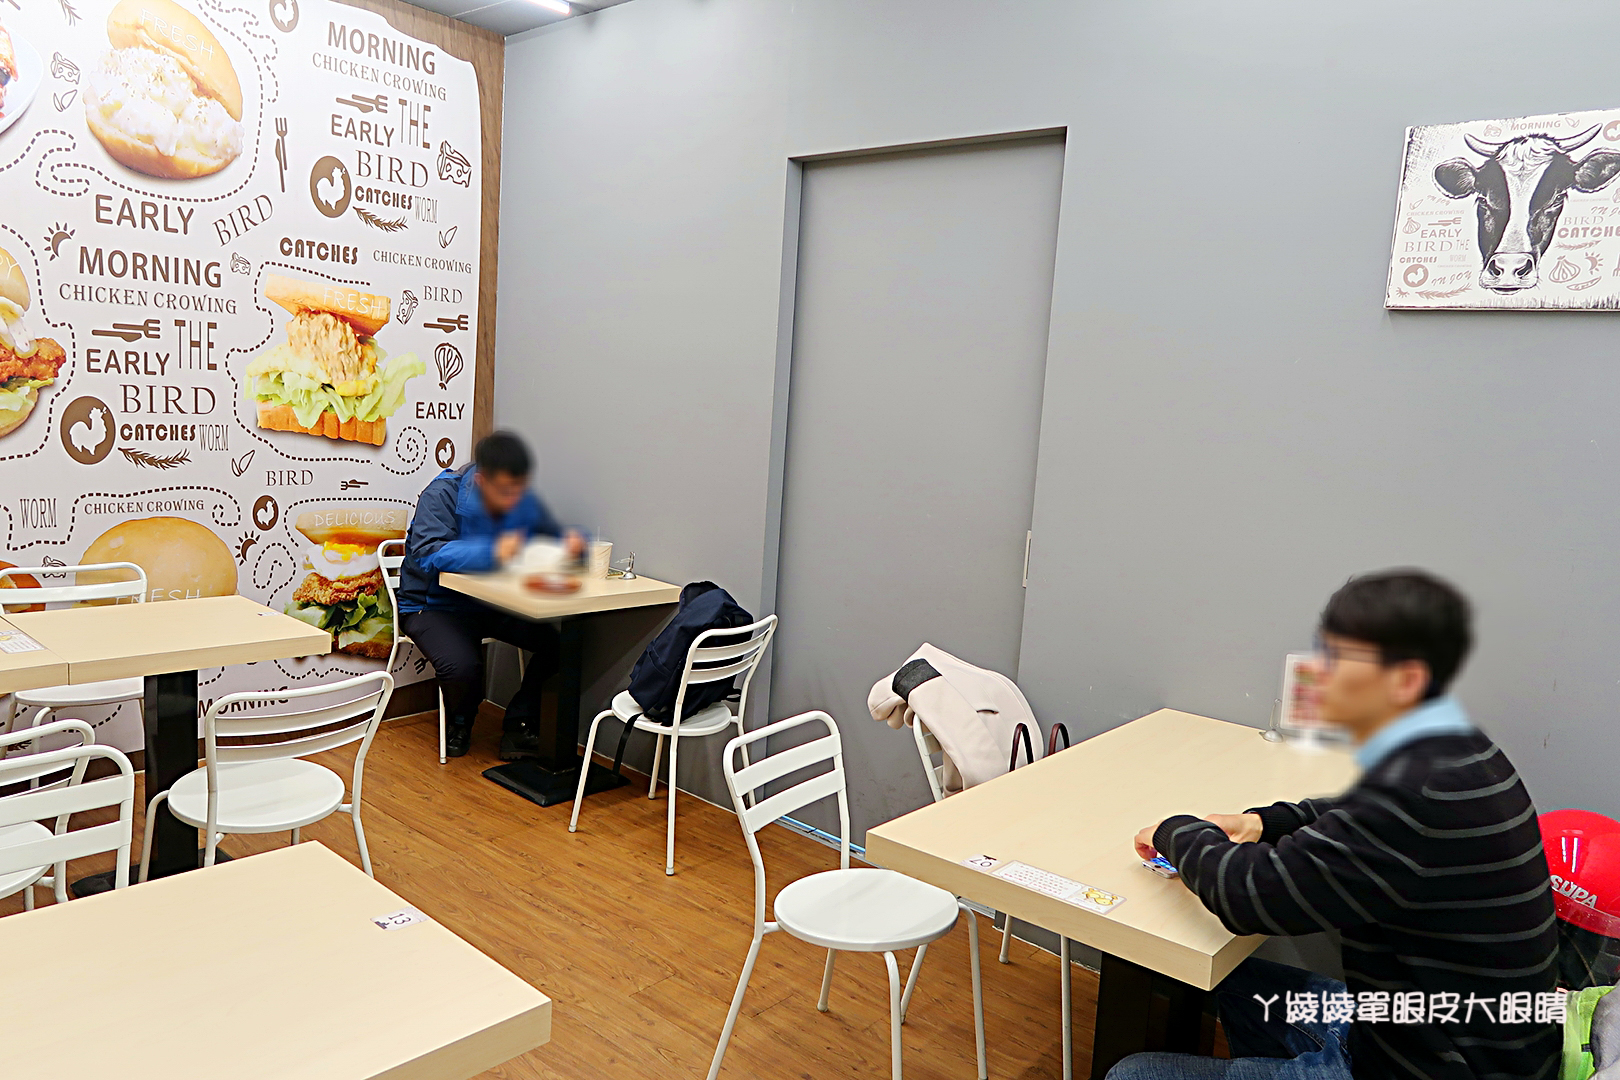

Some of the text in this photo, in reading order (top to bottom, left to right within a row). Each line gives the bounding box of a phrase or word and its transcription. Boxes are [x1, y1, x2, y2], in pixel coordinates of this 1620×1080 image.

[141, 8, 214, 61] FRESH
[328, 21, 435, 75] MORNING
[312, 52, 447, 102] CHICKEN CROWING
[331, 98, 431, 149] EARLY THE
[1510, 120, 1560, 131] MORNING
[355, 150, 428, 188] BIRD
[95, 194, 194, 235] EARLY
[354, 185, 438, 223] CATCHES WORM
[212, 194, 273, 247] BIRD
[1421, 229, 1462, 238] EARLY
[1563, 216, 1604, 225] BIRD
[279, 237, 358, 265] CATCHES
[373, 249, 472, 274] CHICKEN CROWING
[1399, 256, 1437, 264] CATCHES
[1405, 239, 1470, 253] BIRD THE
[79, 246, 222, 288] MORNING
[59, 283, 238, 315] CHICKEN CROWING
[324, 287, 383, 318] FRESH
[423, 285, 463, 304] BIRD
[86, 319, 217, 376] EARLY THE
[119, 384, 216, 415] BIRD
[415, 402, 465, 420] EARLY
[119, 424, 229, 451] CATCHES WORM
[266, 470, 314, 486] BIRD
[19, 498, 57, 529] WORM
[84, 498, 205, 515] CHICKEN CROWING
[314, 511, 396, 527] DELICIOUS
[1550, 874, 1598, 909] SUPA
